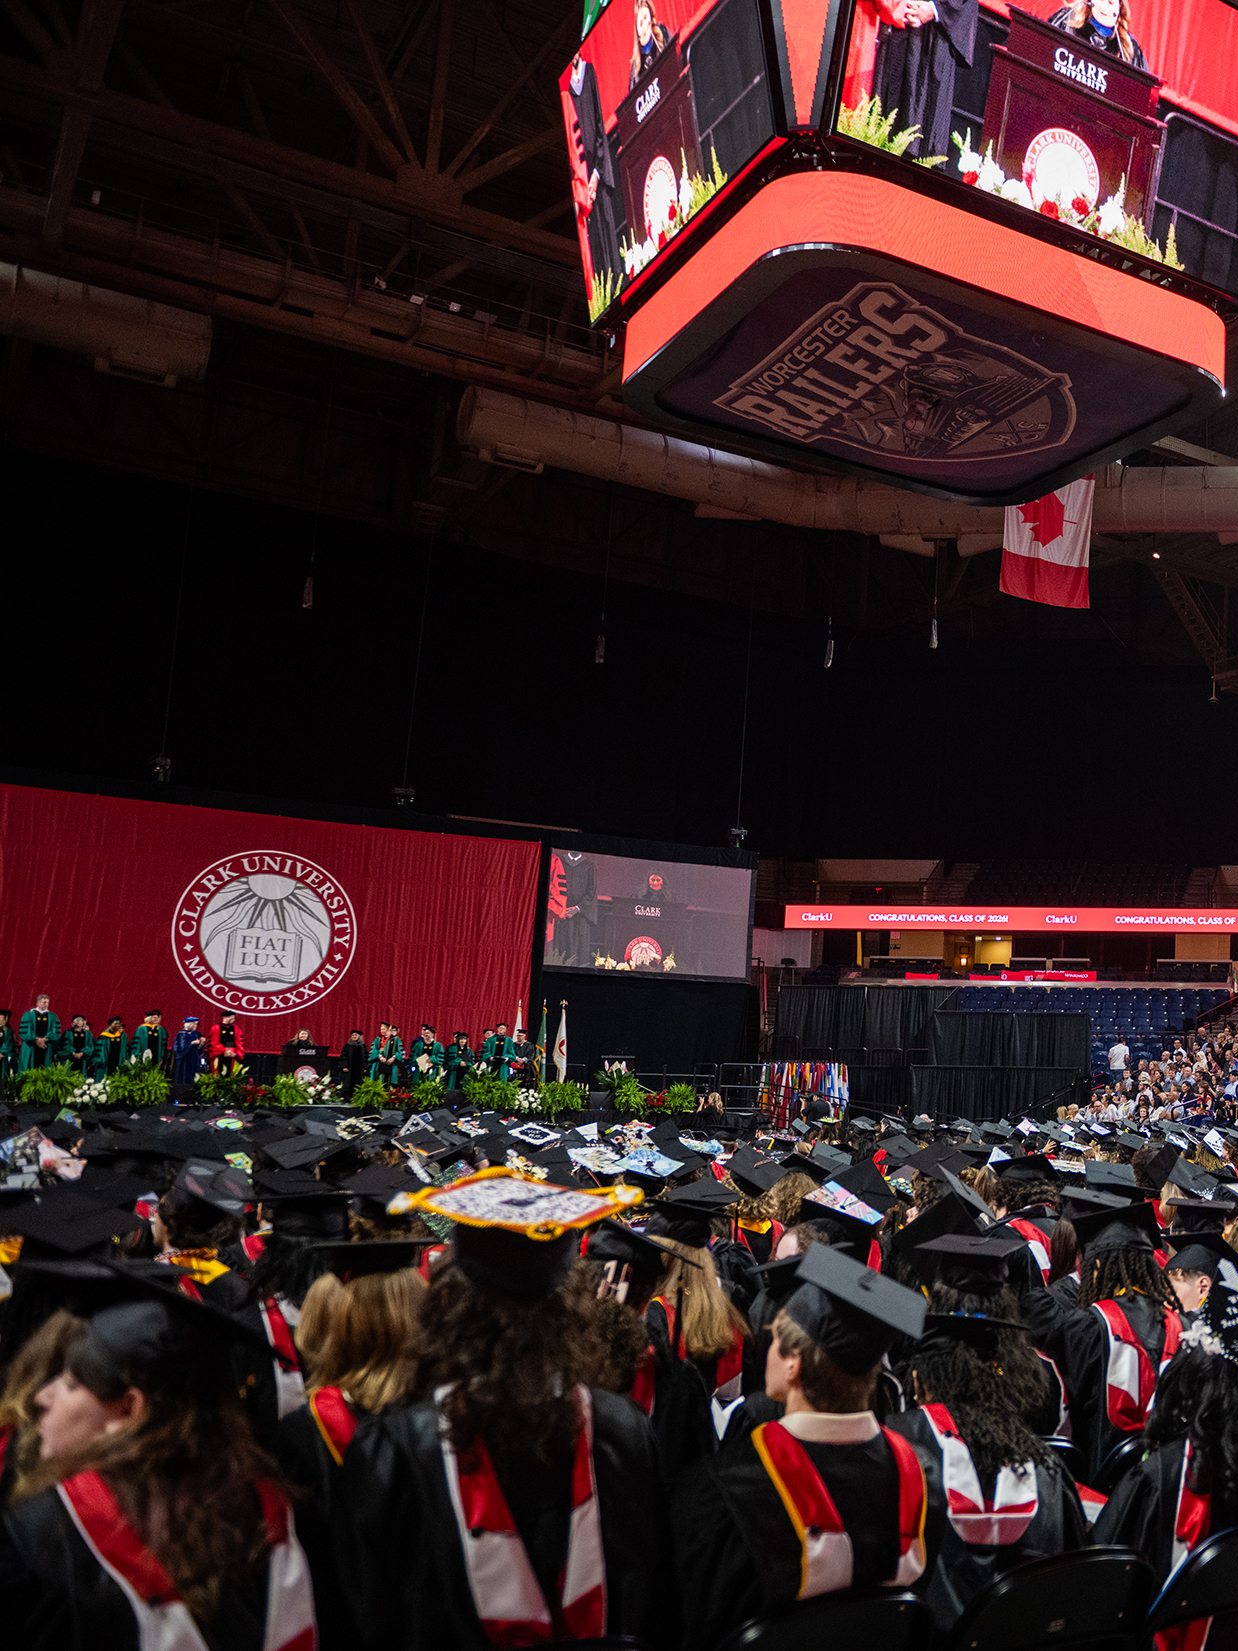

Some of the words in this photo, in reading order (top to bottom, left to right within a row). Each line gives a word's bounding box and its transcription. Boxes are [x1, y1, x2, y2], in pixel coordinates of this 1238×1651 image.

[1053, 61, 1107, 93] UNIVERSITY
[1054, 48, 1109, 86] CLARK
[635, 77, 661, 115] CLARK
[730, 290, 949, 437] RAILERS
[745, 308, 859, 397] WORCESTER
[179, 862, 240, 937] CLARK
[241, 856, 352, 949] UNIVERSITY
[634, 905, 662, 913] CLARK
[802, 912, 833, 922] ClarkU
[868, 913, 948, 923] CONGRATULATIONS,
[948, 914, 974, 923] CLASS
[974, 914, 987, 923] OF
[987, 914, 1009, 923] 2026!
[1045, 914, 1078, 924] ClarkU
[1114, 915, 1197, 926] CONGRATULATIONS,
[1197, 916, 1223, 925] CLASS
[1223, 916, 1237, 925] OF
[240, 935, 291, 952] FIAT
[239, 952, 288, 968] LUX
[184, 955, 340, 1010] MDCCCLXXXVII
